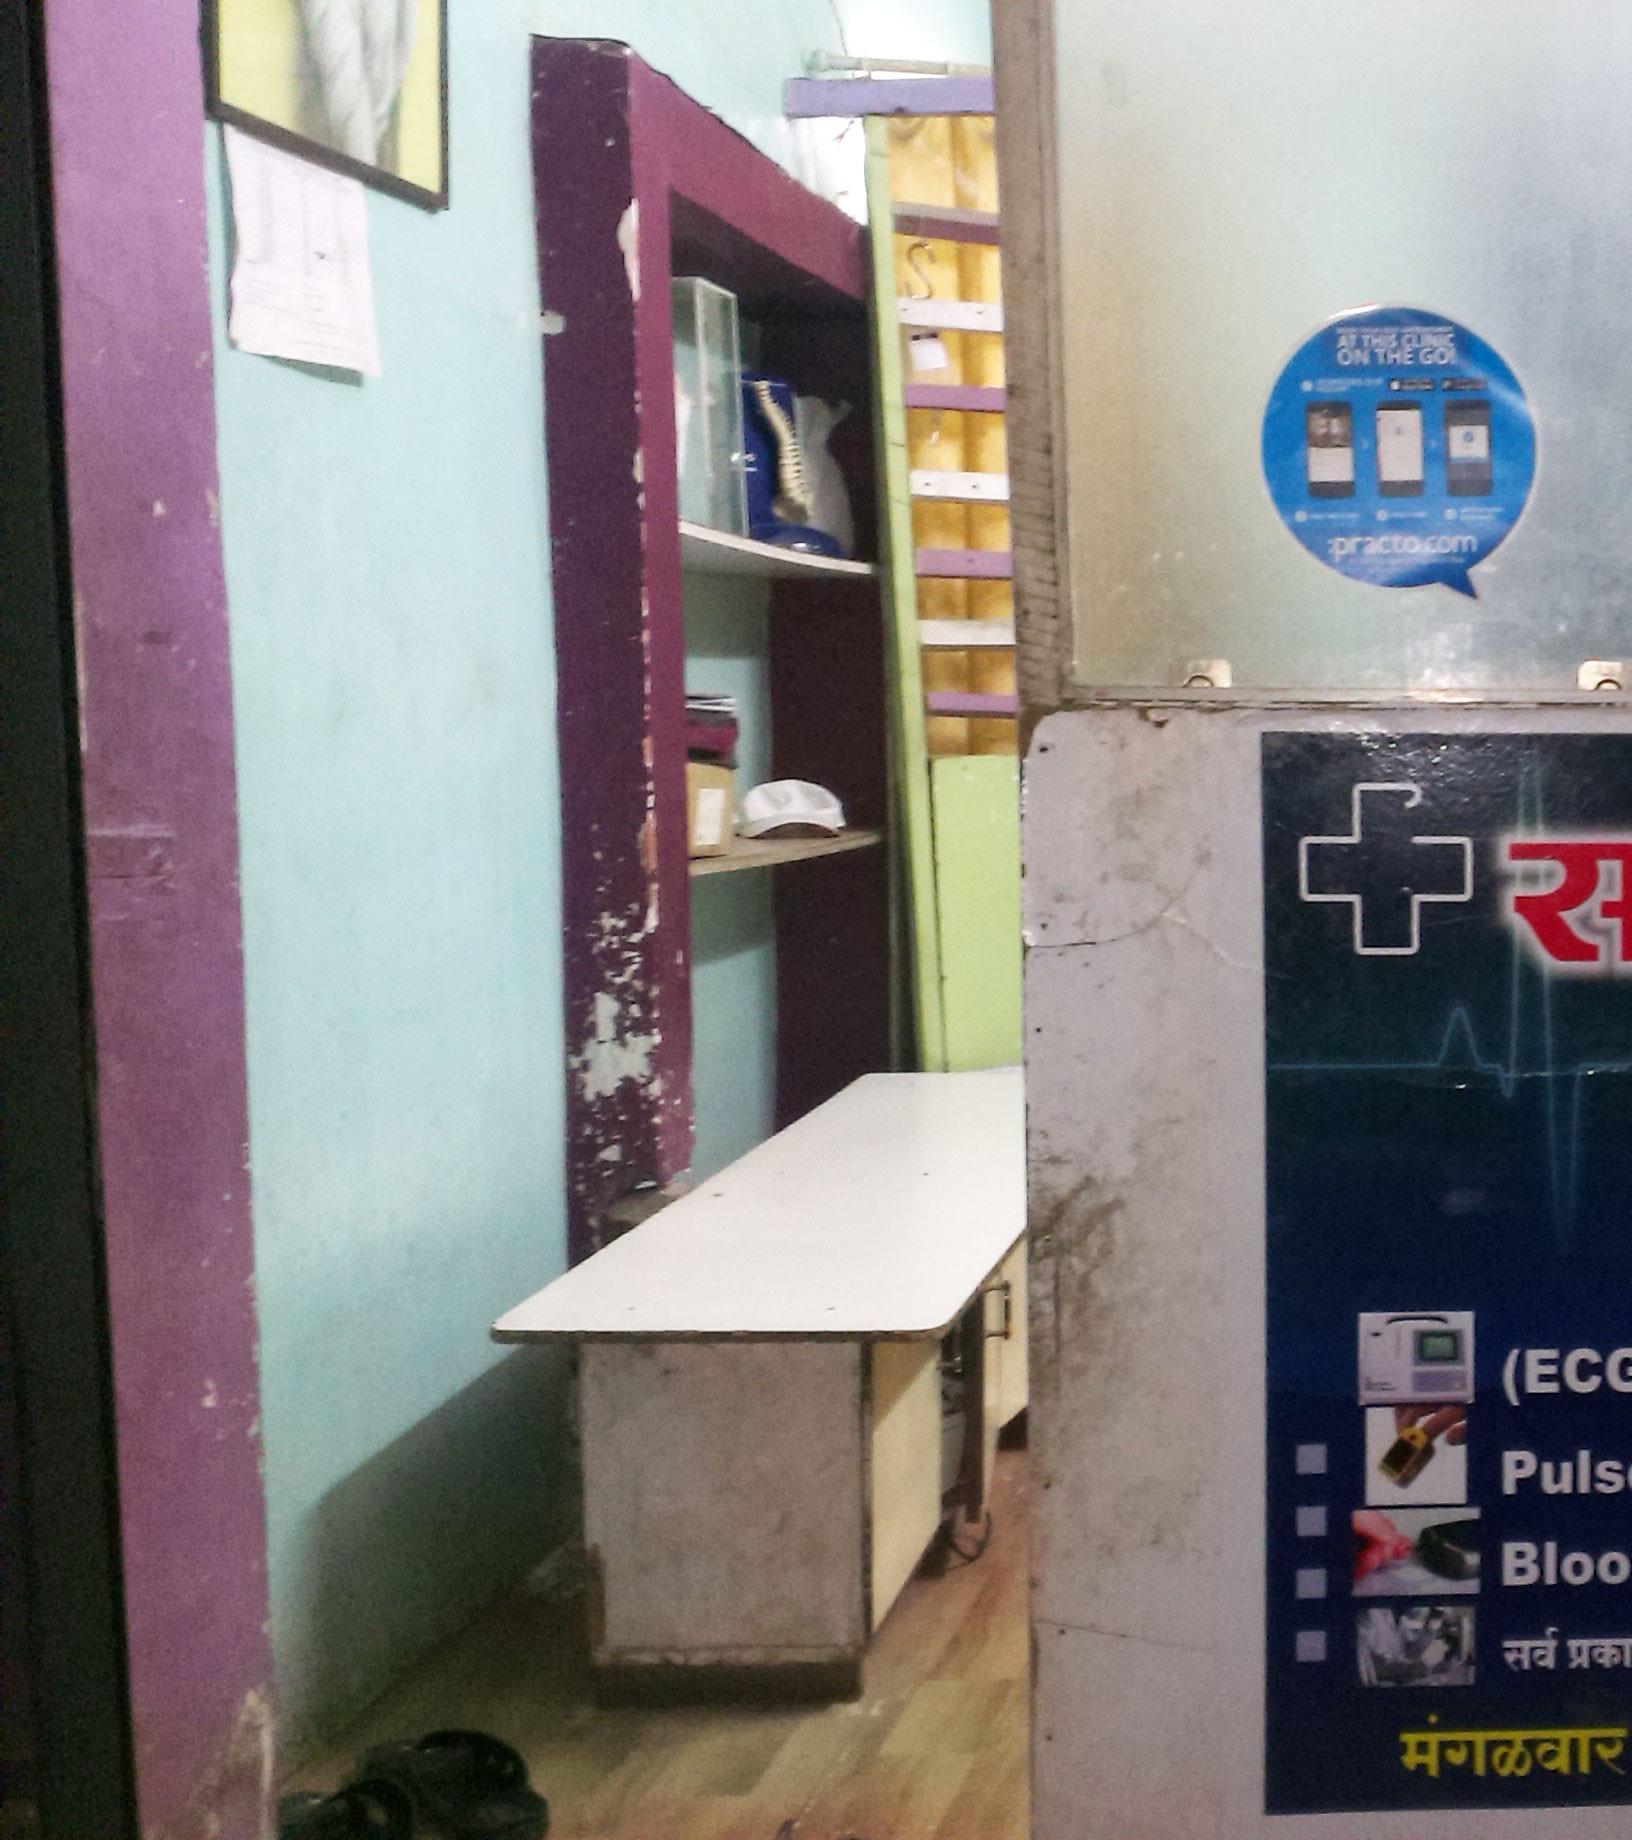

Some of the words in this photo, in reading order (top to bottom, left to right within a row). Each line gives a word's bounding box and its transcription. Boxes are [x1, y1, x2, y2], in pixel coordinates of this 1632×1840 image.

[1337, 348, 1370, 365] ON
[1374, 348, 1414, 365] THE
[1501, 1626, 1560, 1671] सर्व
[1398, 1711, 1631, 1778] मंगळवार
